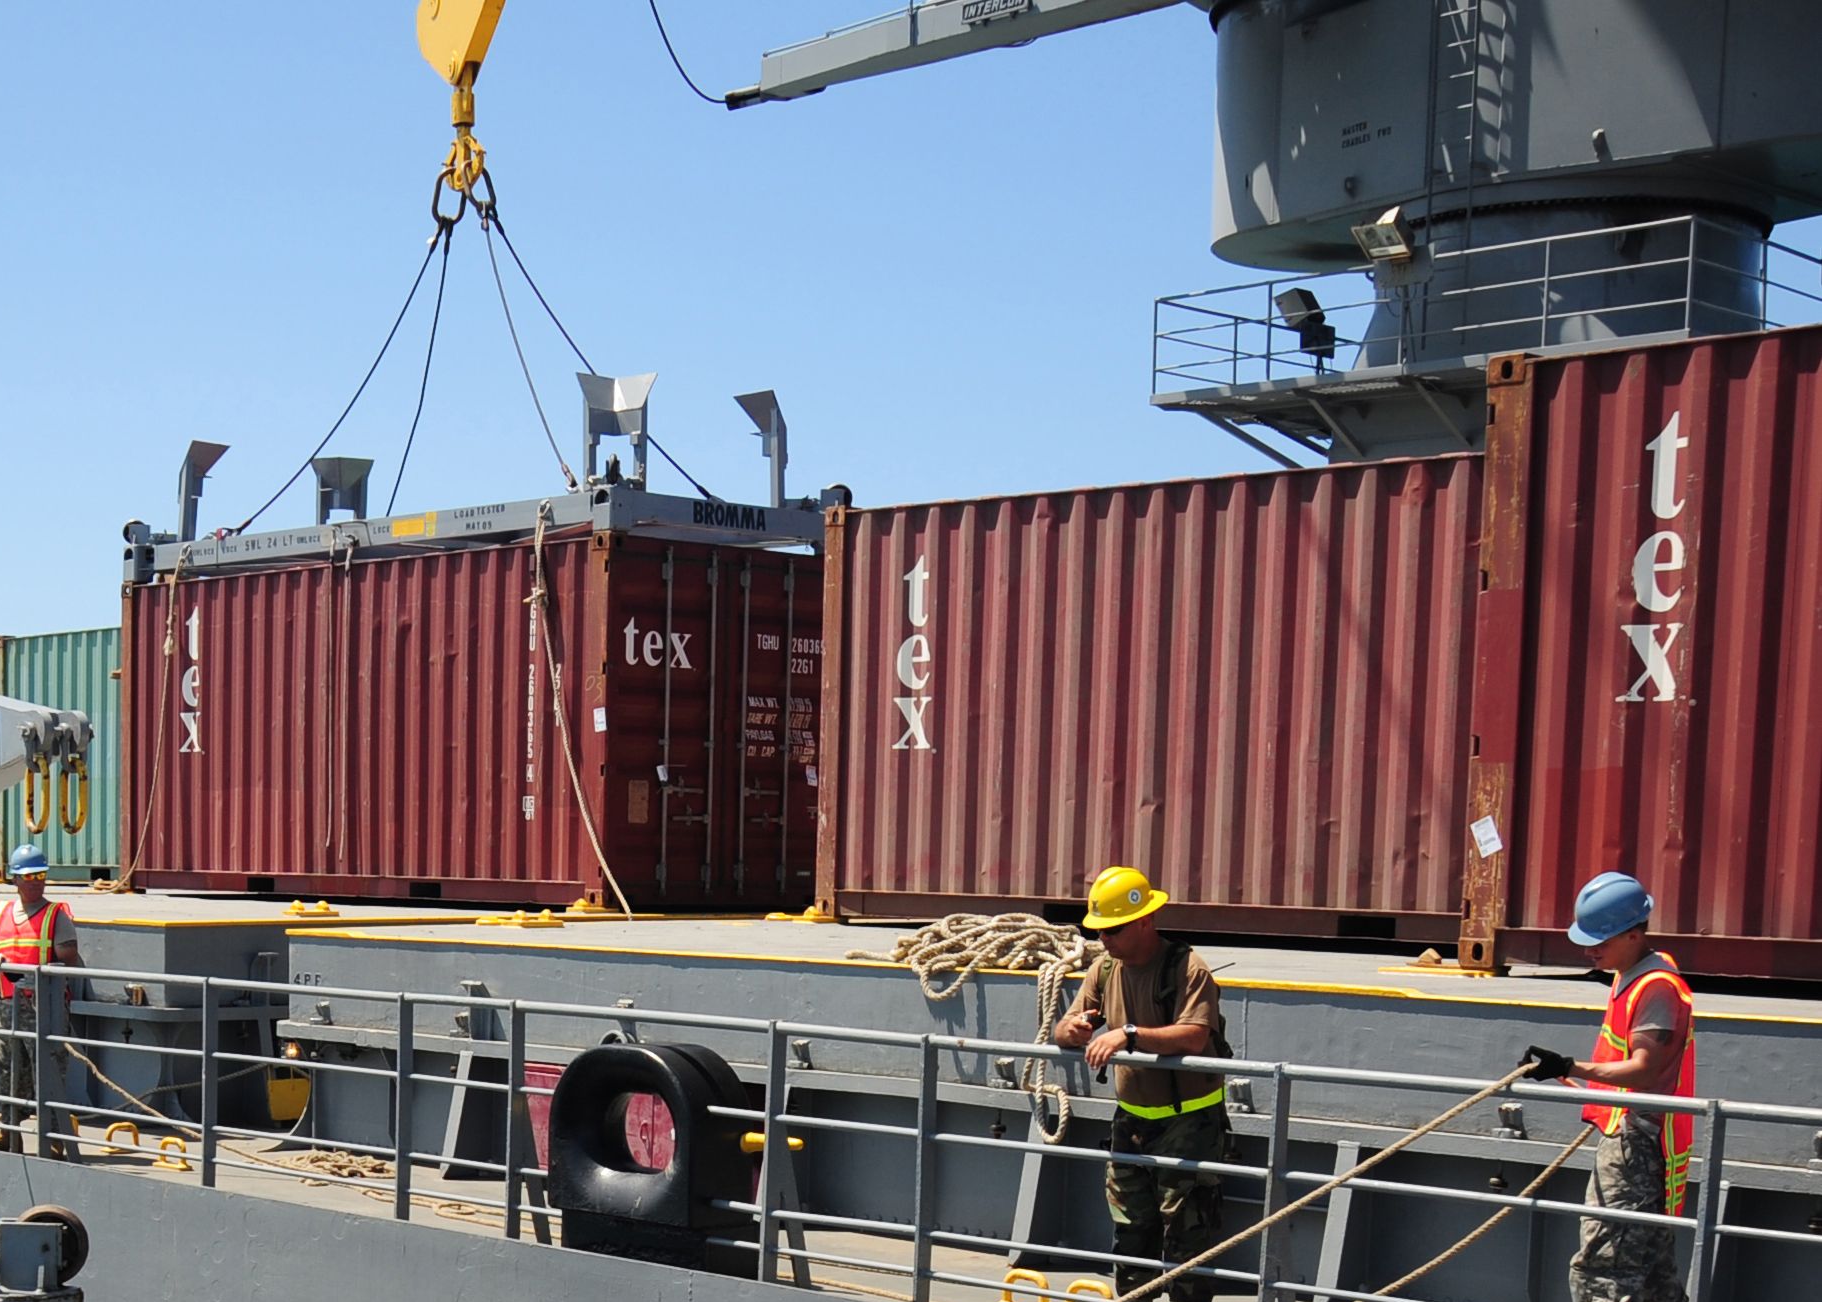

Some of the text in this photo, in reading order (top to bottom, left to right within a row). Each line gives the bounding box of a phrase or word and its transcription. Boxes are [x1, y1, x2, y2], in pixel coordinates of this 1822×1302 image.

[454, 504, 506, 519] LOAD TESTED
[693, 501, 766, 531] BROMMA
[245, 541, 261, 551] SWL
[267, 537, 277, 548] 24
[283, 534, 293, 546] LT
[1615, 410, 1689, 702] tex
[624, 616, 692, 669] tex
[757, 633, 780, 651] TGHU
[892, 555, 932, 749] tex
[179, 606, 201, 752] tex
[791, 658, 814, 674] 22G1
